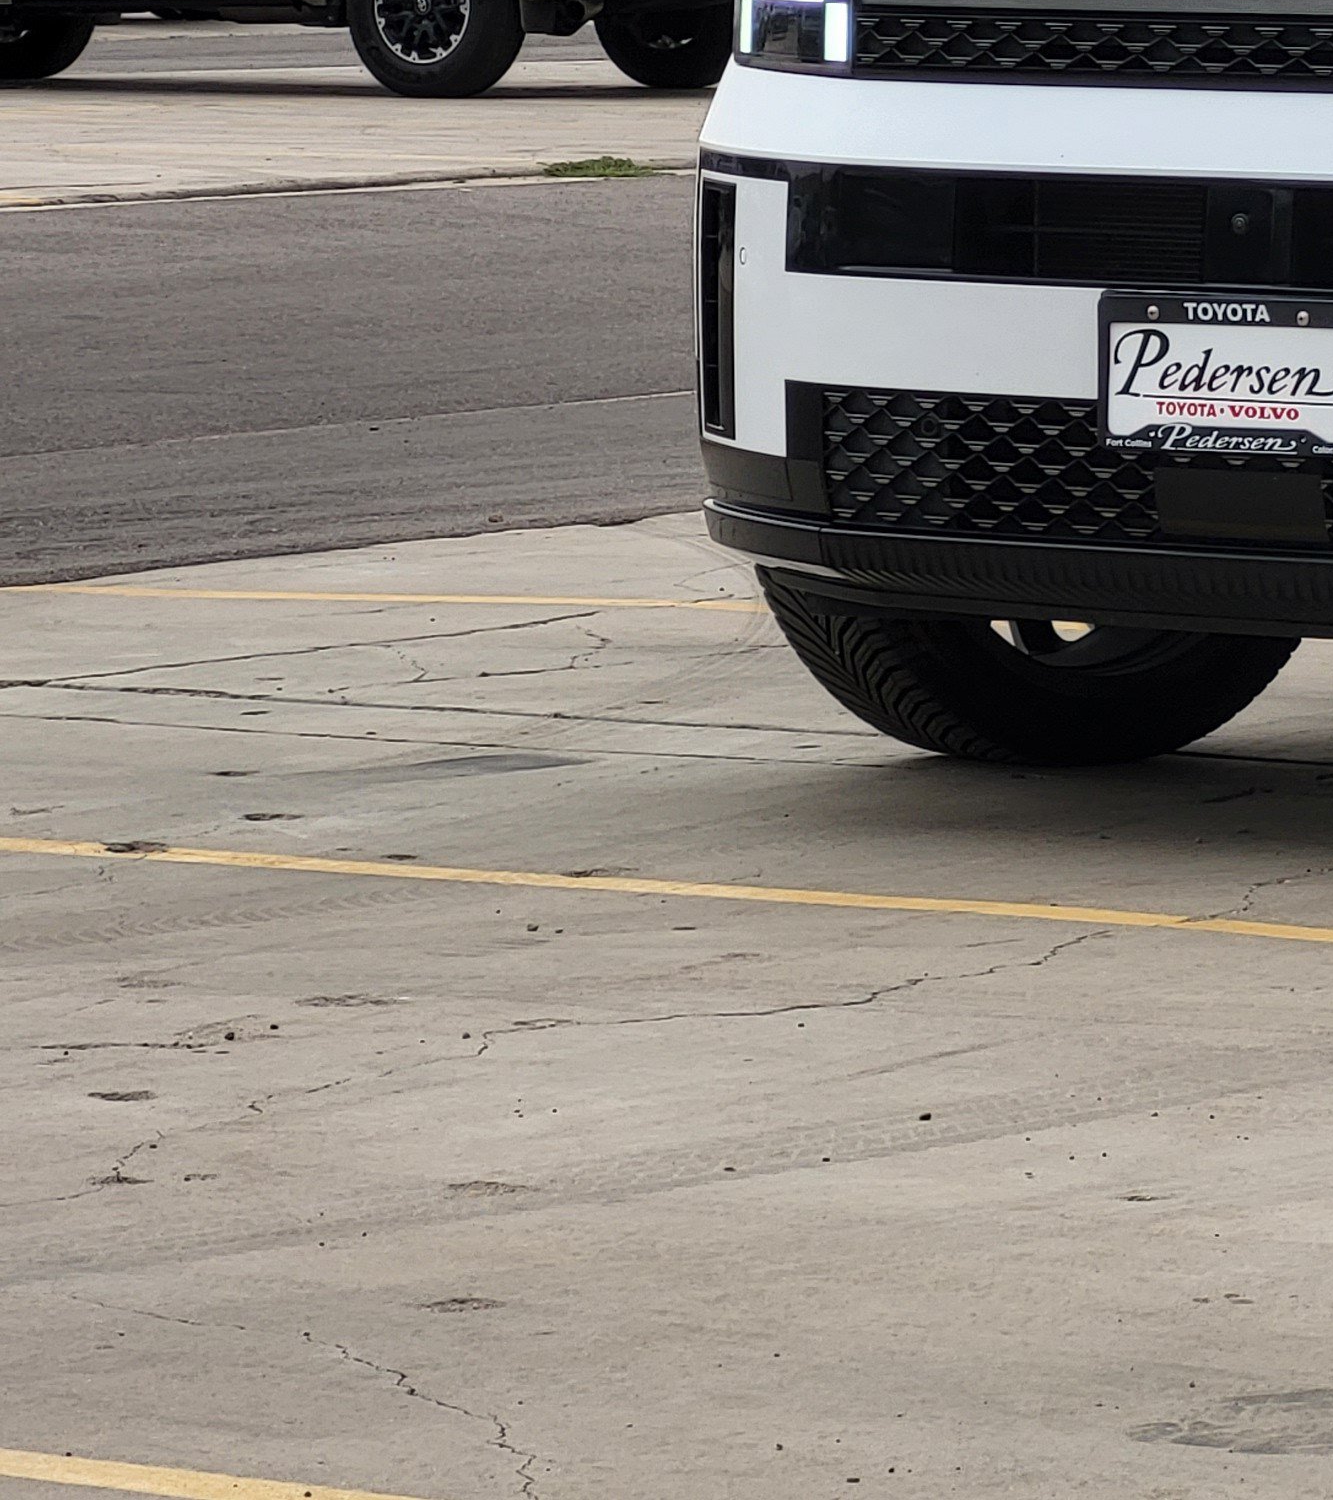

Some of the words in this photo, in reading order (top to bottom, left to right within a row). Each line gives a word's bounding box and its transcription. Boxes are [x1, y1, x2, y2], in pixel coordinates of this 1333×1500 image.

[1183, 302, 1271, 323] TOYOTA
[1156, 401, 1217, 417] TOYOTA
[1228, 405, 1299, 421] VOLVO
[1105, 438, 1123, 447] Fort
[1157, 423, 1297, 451] Pedersen
